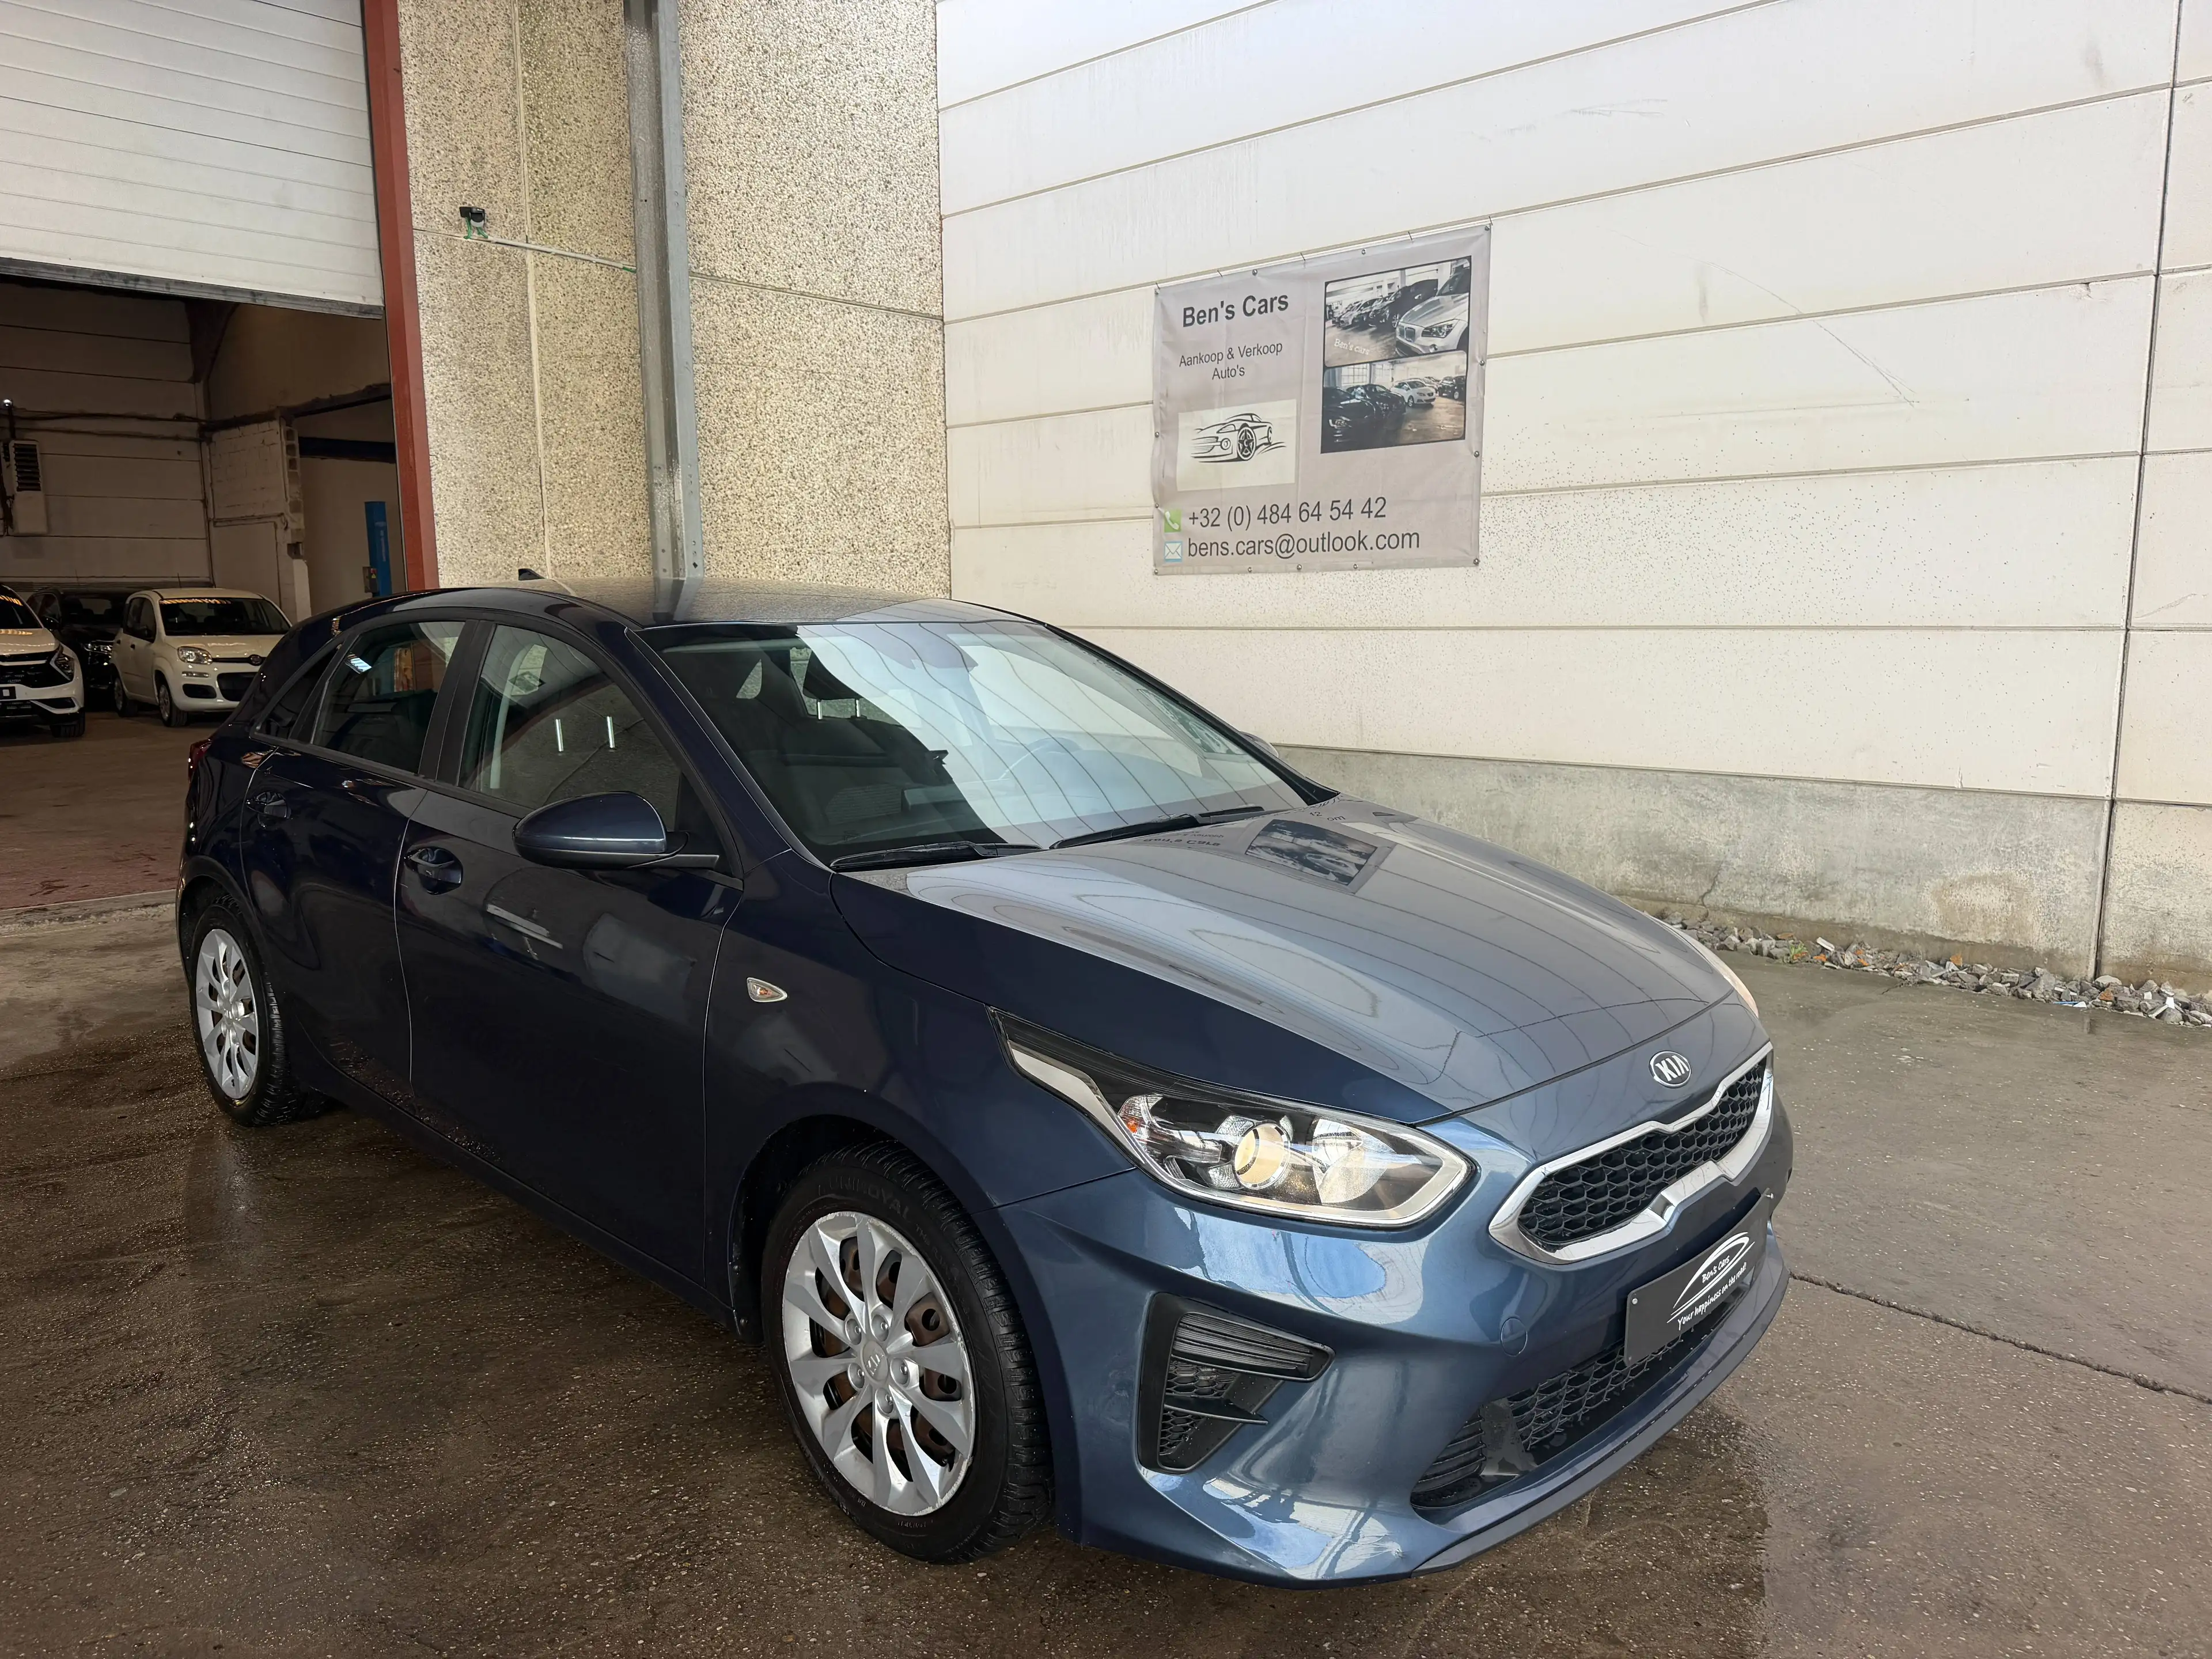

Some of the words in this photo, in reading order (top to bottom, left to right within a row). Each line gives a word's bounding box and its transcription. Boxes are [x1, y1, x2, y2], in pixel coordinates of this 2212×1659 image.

[1183, 300, 1236, 328] Ben's
[1242, 294, 1289, 317] Cars
[1179, 351, 1224, 368] Aankoop
[1226, 347, 1235, 360] &
[1238, 343, 1283, 358] Verkoop
[1334, 338, 1354, 351] Ben's
[1211, 364, 1245, 380] Auto's
[1188, 507, 1221, 528] +32
[1227, 505, 1251, 532] (0)
[1257, 502, 1291, 525] 484
[1298, 501, 1322, 523] 64
[1329, 498, 1354, 521] 54
[1360, 496, 1387, 518] 42
[1188, 530, 1420, 559] bens.cars@outlook.com
[1654, 1055, 1690, 1082] KIA
[1677, 1310, 1694, 1331] Your
[1694, 1289, 1721, 1316] happiness
